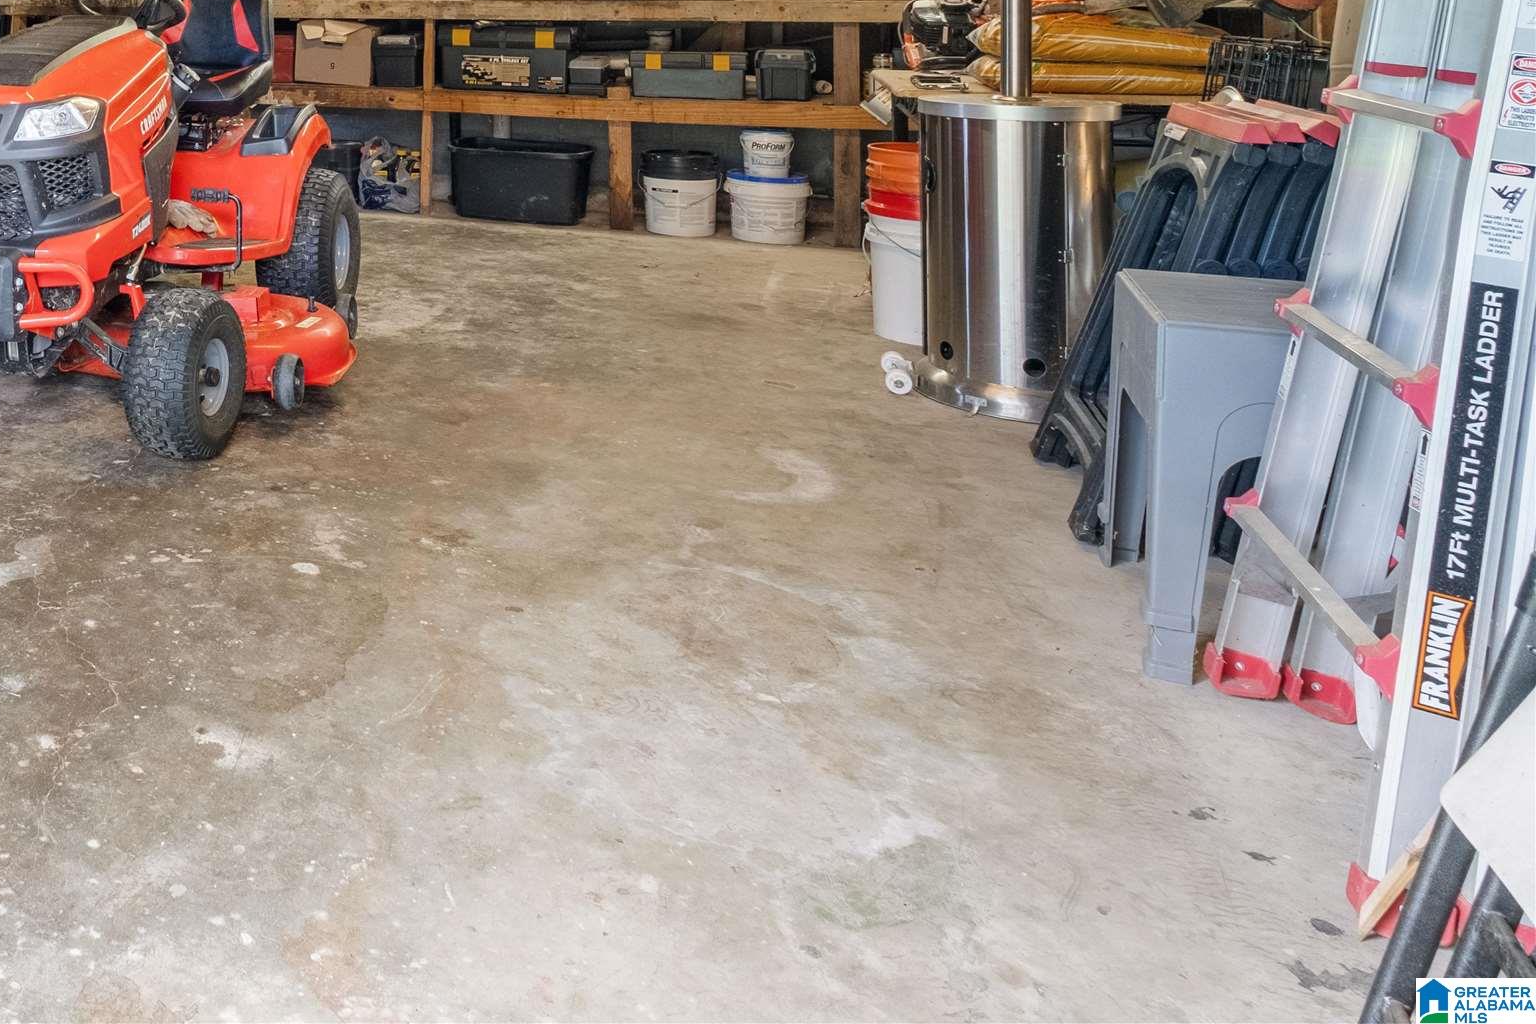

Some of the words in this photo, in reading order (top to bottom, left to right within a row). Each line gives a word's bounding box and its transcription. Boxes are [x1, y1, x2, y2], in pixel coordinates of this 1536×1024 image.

[140, 94, 169, 136] CRAFTSMAN
[1472, 289, 1504, 384] LADDER
[1452, 388, 1491, 528] MULTI-TASK
[1445, 531, 1471, 580] 17Ft
[1418, 595, 1467, 714] FRANKLIN
